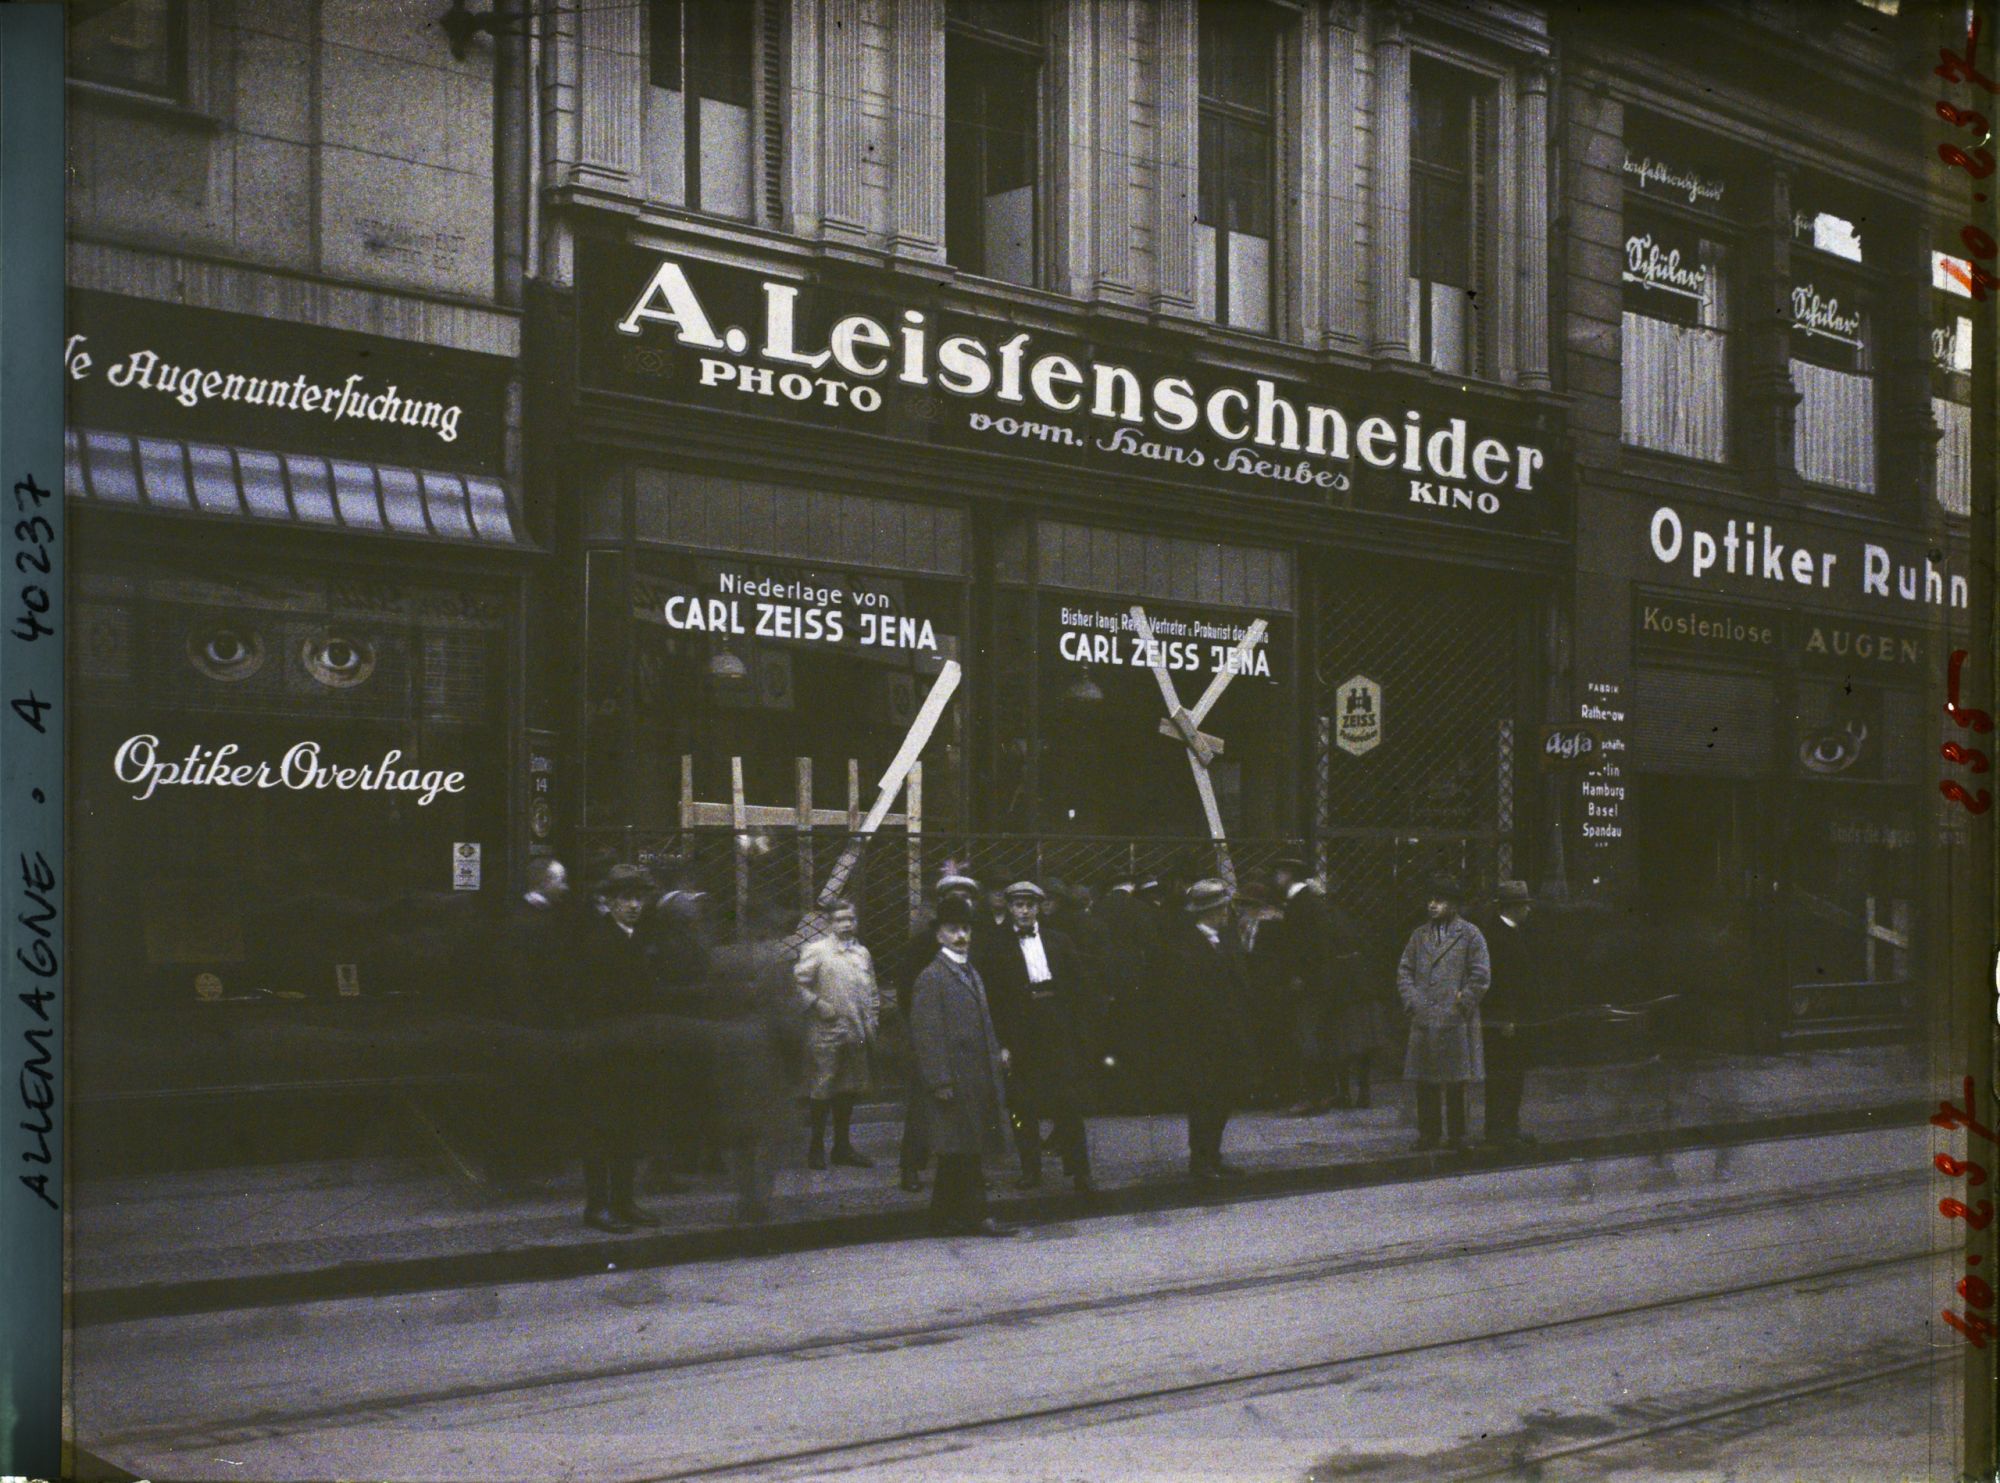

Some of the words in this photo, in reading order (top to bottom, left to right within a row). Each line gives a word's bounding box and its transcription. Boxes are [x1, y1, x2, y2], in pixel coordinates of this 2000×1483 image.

[618, 261, 749, 356] A.
[762, 282, 1544, 491] Leistenschneider
[699, 357, 882, 412] PHOTO
[970, 412, 1083, 447] vorm.
[1097, 427, 1206, 468] Hans
[1213, 448, 1350, 491] Heubes
[1410, 480, 1500, 514] KINO
[1650, 507, 1836, 587] Optiker
[1864, 543, 1969, 609] Ruhn
[719, 573, 842, 606] Niederlage
[852, 592, 889, 608] von
[664, 596, 745, 634] CARL
[755, 603, 844, 642] ZEISS
[860, 613, 938, 651] JENA
[1060, 607, 1094, 628] Bisher
[1643, 606, 1772, 643] Kostenlose
[1059, 632, 1124, 664] CARL
[1131, 638, 1200, 672] ZEISS
[1211, 645, 1271, 678] JENA
[1342, 713, 1376, 728] ZEISS
[1545, 731, 1592, 759] Agfa
[114, 734, 280, 800] Optiker
[280, 741, 465, 806] Overhage
[1582, 782, 1625, 800] Hamburg
[1588, 802, 1618, 817] Basel
[1582, 822, 1622, 839] Spandau
